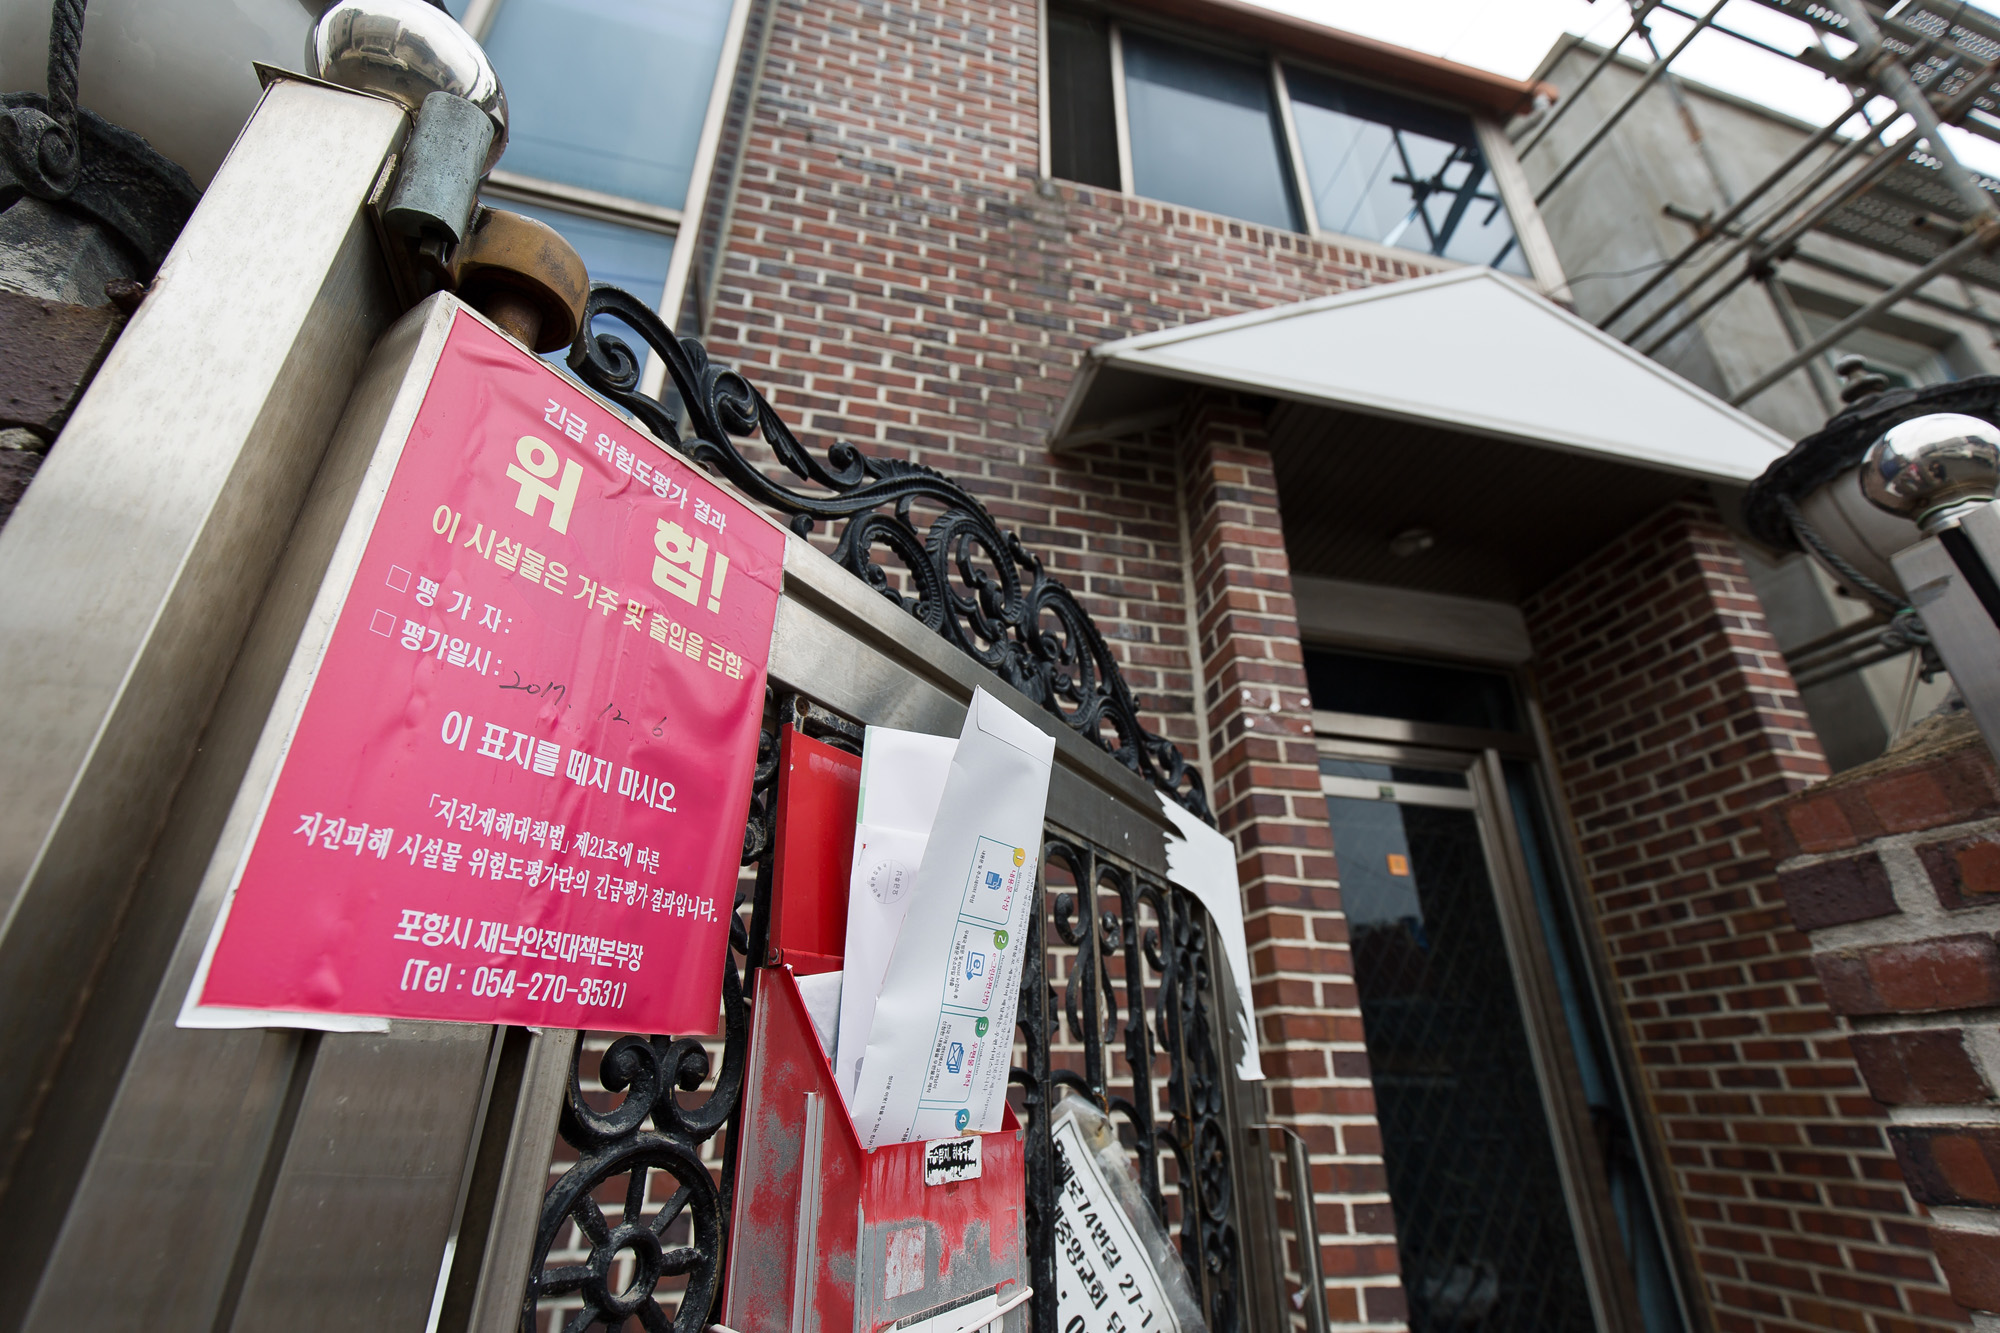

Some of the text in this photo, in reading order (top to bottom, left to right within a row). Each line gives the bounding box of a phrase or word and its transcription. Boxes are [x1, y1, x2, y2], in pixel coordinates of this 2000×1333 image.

[544, 398, 727, 535] 긴급 위험도평가 결과
[506, 435, 730, 614] 위 험!
[415, 576, 440, 608] 평
[448, 590, 472, 621] 가
[432, 505, 744, 680] 이 시설물은 거주 및 출입을 금함.
[442, 710, 677, 814] 이 표지를 떼지 마시오.
[652, 716, 668, 737] 6
[293, 812, 718, 923] 지진피해 시설물 위험도평가단의 긴급평가 결과입니다.
[429, 793, 660, 875] 「지진재해대책법」 제21조에 따른
[394, 909, 644, 972] 포항시 재난안전대책본부장
[998, 935, 1006, 943] 2
[959, 1114, 967, 1123] 4
[1118, 1273, 1153, 1329] 27-1
